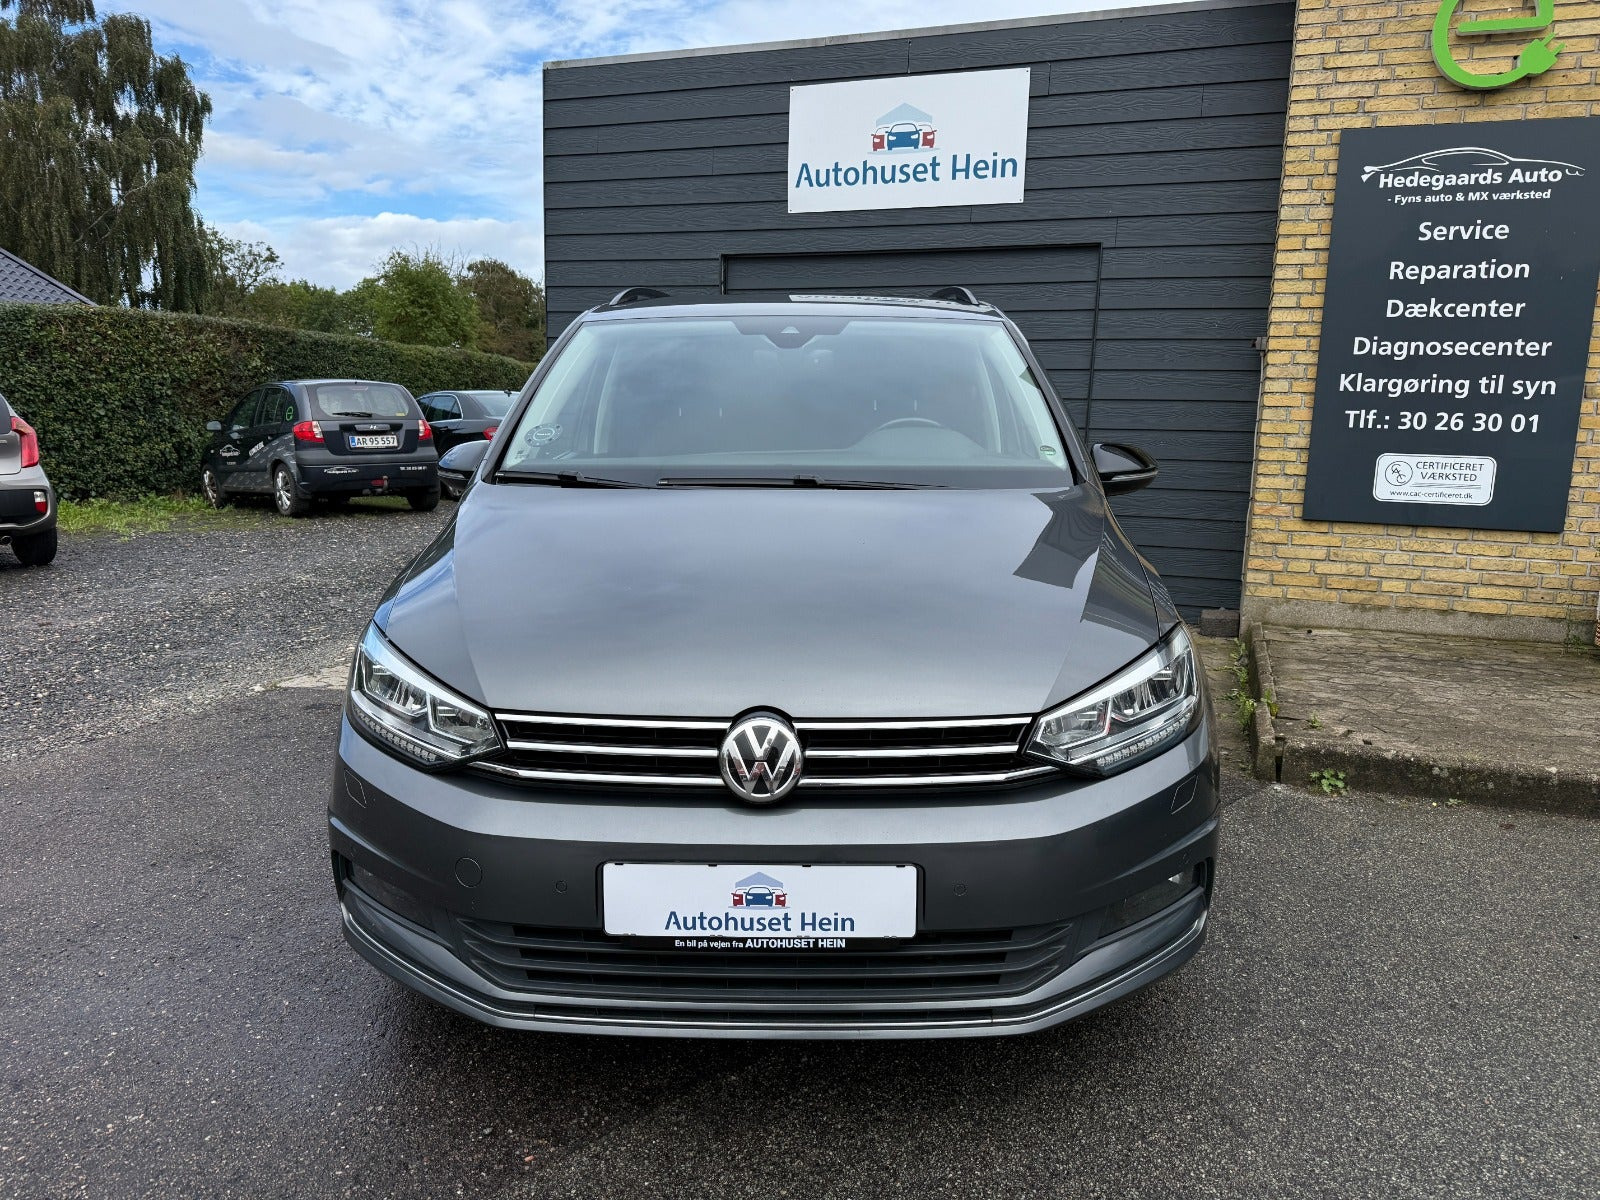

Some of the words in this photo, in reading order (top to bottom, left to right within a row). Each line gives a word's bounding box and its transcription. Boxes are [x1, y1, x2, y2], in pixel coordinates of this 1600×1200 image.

[795, 155, 941, 188] Autohuset
[951, 152, 1018, 181] Hein
[1379, 169, 1503, 190] Hedegaards
[1508, 167, 1563, 184] Auto
[1394, 194, 1422, 205] Fyns
[1425, 193, 1453, 203] auto
[1455, 192, 1465, 202] &
[1468, 191, 1489, 201] MX
[1492, 189, 1551, 200] værksted
[1418, 220, 1510, 241] Service
[1389, 259, 1530, 284] Reparation
[1386, 298, 1526, 318] Dækcenter
[1353, 336, 1552, 360] Diagnosecenter
[1339, 373, 1470, 398] Klargøring
[1479, 375, 1504, 395] til
[1511, 379, 1557, 399] syn
[1345, 409, 1390, 430] Tlf.:
[1397, 411, 1427, 430] 30
[1434, 412, 1464, 431] 26
[1472, 413, 1502, 432] 30
[1510, 413, 1539, 432] 01
[357, 437, 367, 445] AR
[369, 437, 380, 445] 95
[380, 437, 396, 445] 557
[1416, 461, 1485, 472] CERTIFICERET
[1420, 471, 1477, 482] VÆRKSTED
[1389, 490, 1473, 499] www.cac-certificeret.dk
[664, 911, 792, 932] Autohuset
[800, 912, 855, 932] Hein
[675, 939, 685, 947] En
[686, 939, 697, 947] bil
[698, 939, 708, 949] på
[709, 940, 731, 950] vejen
[732, 940, 744, 948] fra
[745, 938, 815, 948] AUTOHUSET
[818, 938, 846, 948] HEIN
